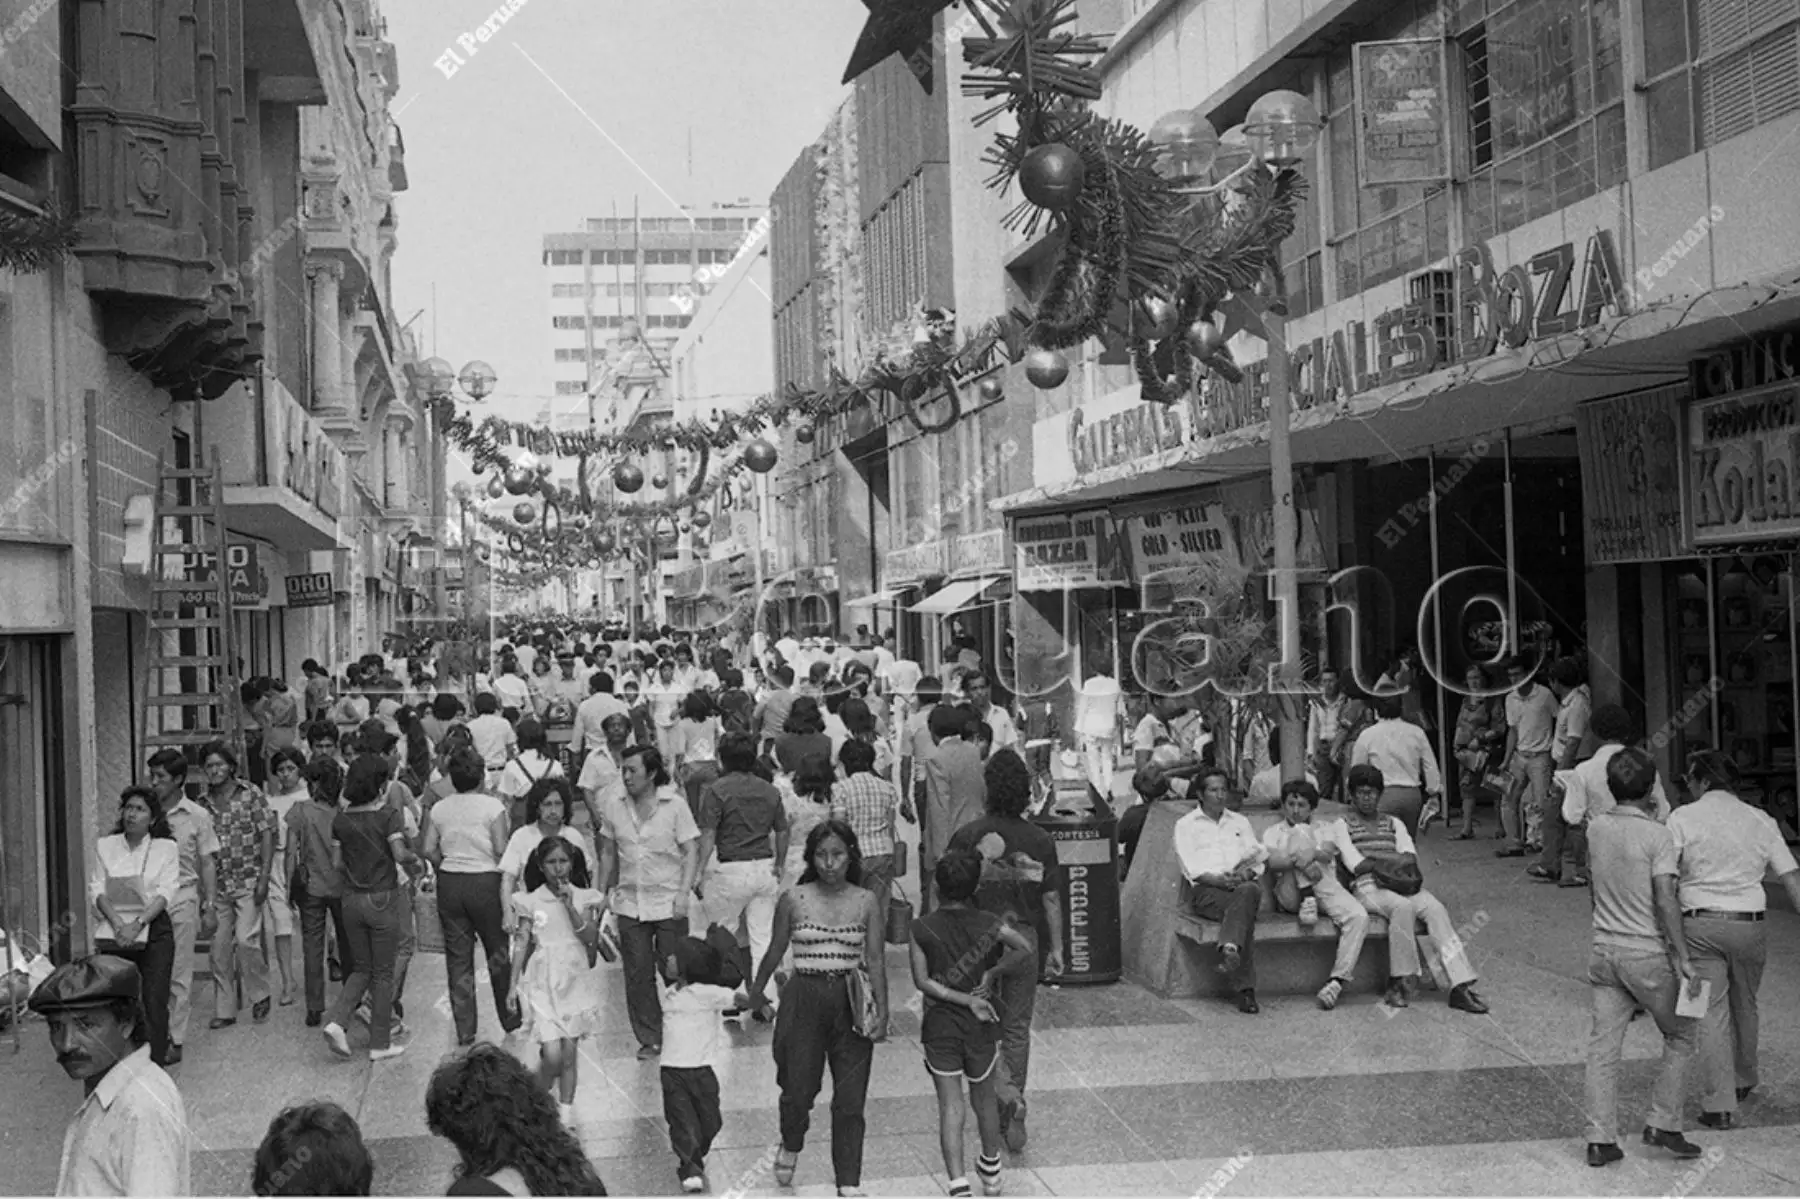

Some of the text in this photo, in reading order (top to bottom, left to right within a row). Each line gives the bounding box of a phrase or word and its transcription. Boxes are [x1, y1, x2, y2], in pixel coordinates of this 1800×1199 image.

[1454, 228, 1624, 364] BOZA
[1179, 528, 1224, 554] SILVER
[287, 575, 329, 593] ORO
[1069, 865, 1090, 973] PAPELES
